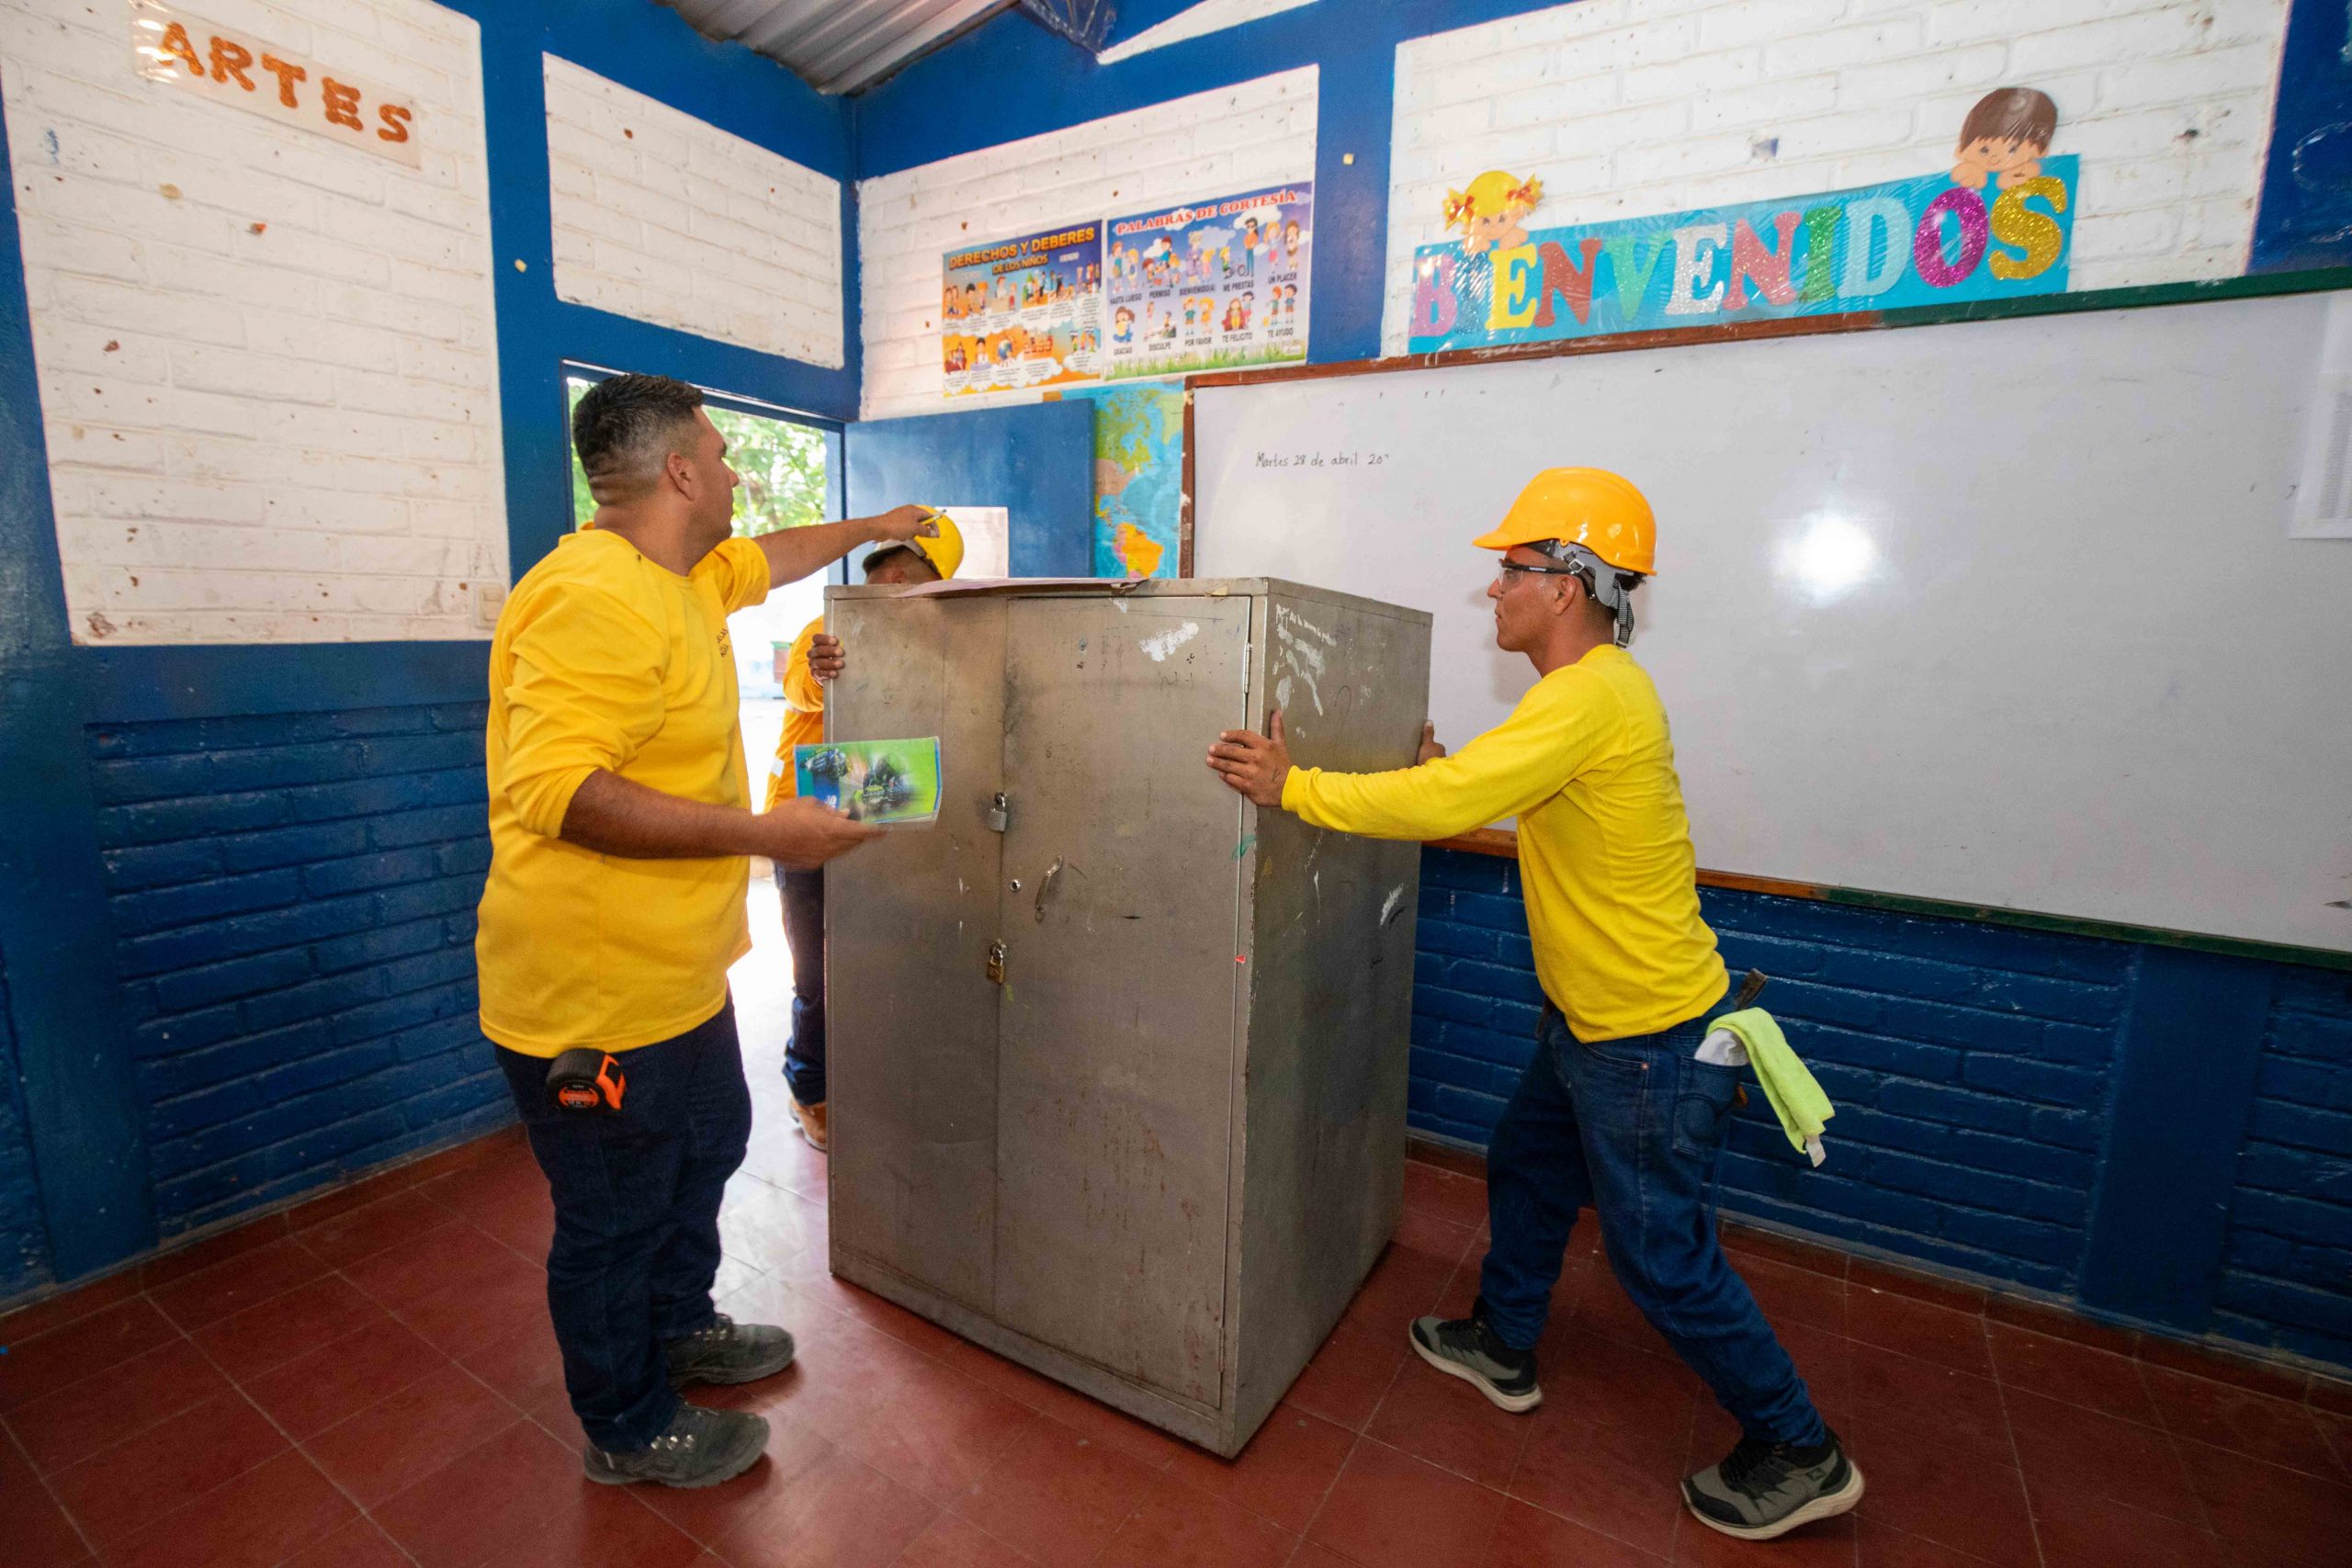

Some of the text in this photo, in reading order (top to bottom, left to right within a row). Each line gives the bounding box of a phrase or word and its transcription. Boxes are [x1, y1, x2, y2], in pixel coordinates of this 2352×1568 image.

[159, 20, 413, 143] ARTES
[1115, 190, 1295, 235] PALABRAS DE CORTESÍA
[948, 227, 1094, 270] DERECHOS Y DEBERES
[1410, 174, 2068, 337] BIENVENIDOS
[992, 263, 1005, 275] DE
[1005, 261, 1021, 273] LOS
[1022, 254, 1048, 269] NIÑOS
[1268, 272, 1297, 284] UN PLACER
[1223, 279, 1254, 292] ME PRESTAS
[1125, 293, 1142, 303] LUEGO
[1149, 288, 1171, 299] PERMISO
[1222, 332, 1252, 344] TE FELICITO
[1267, 327, 1294, 338] TE AYUDO
[1148, 343, 1171, 352] DISCULPE
[1184, 336, 1212, 347] POR FAVOR
[1256, 451, 1288, 468] Martes
[1294, 455, 1306, 467] 28
[1310, 451, 1324, 468] de
[1330, 451, 1358, 467] abril
